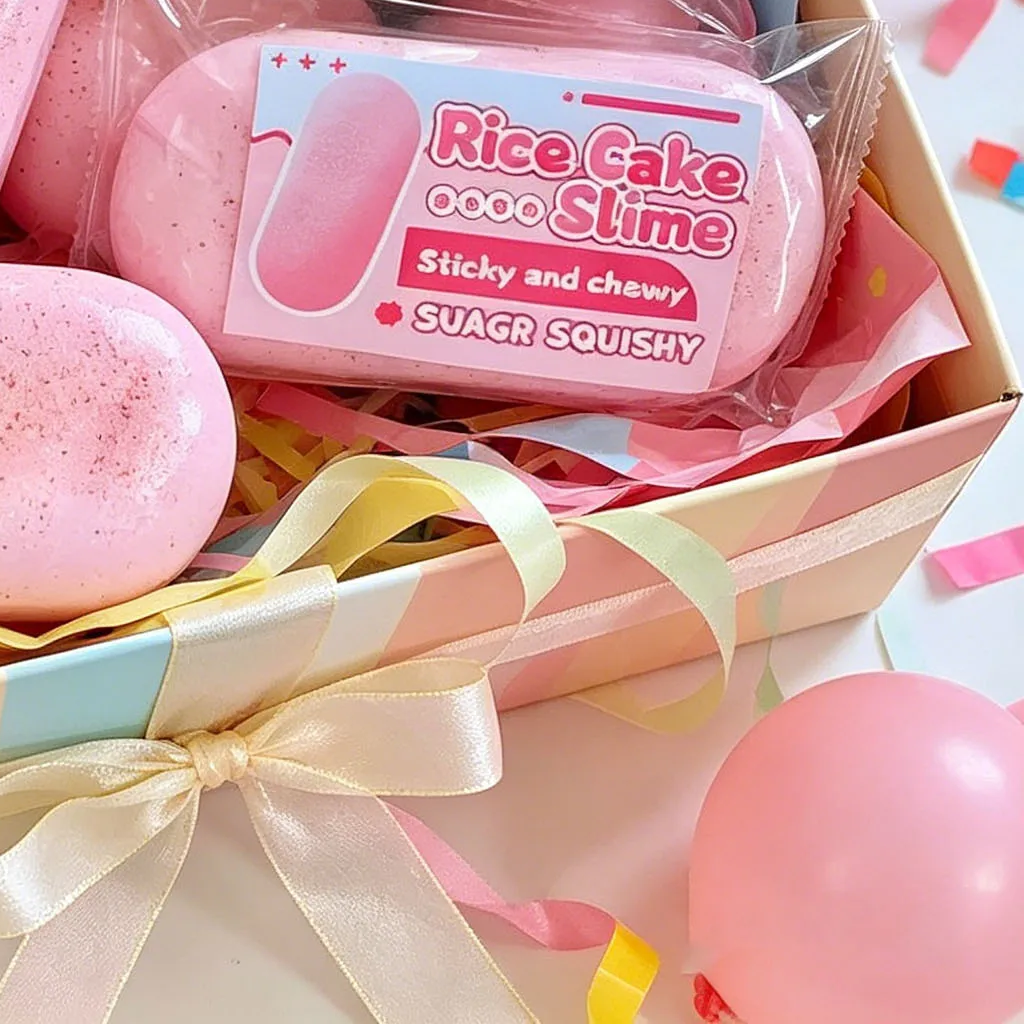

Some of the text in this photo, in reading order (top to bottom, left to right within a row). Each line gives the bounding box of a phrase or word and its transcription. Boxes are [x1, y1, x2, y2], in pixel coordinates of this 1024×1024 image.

[428, 101, 747, 201] Rice Cake
[547, 177, 736, 259] Slime
[417, 248, 689, 308] Sticky and chewy
[412, 302, 704, 365] SUAGR SQUISHY
